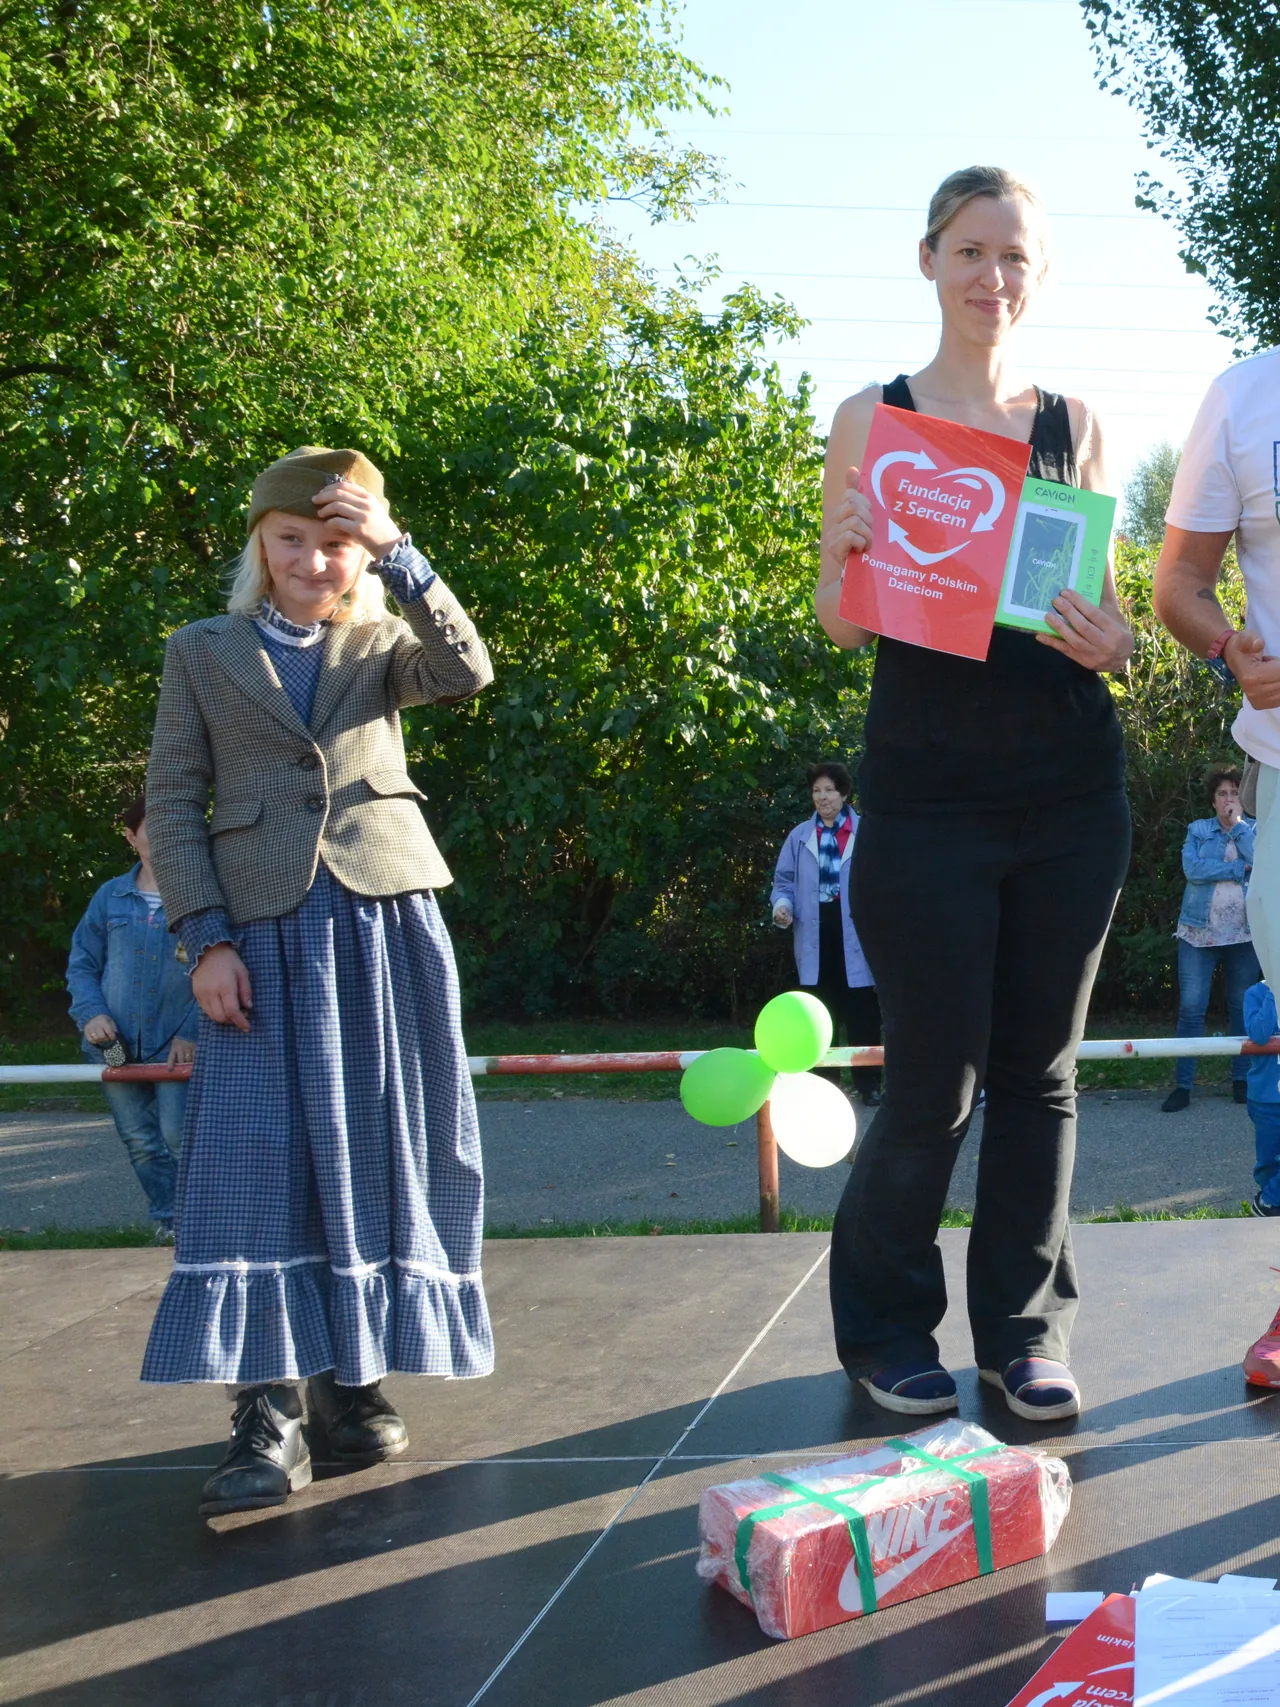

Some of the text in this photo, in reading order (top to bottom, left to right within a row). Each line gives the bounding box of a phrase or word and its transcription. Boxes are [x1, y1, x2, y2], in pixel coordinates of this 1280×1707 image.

[898, 478, 971, 511] Fundacja
[1035, 486, 1076, 504] CAVION
[893, 500, 967, 528] z Sercem
[861, 553, 978, 593] Pomagamy Polskim
[1032, 557, 1057, 569] CAVION
[888, 577, 943, 600] Dzieciom
[867, 1489, 956, 1562] NIKE
[1096, 1634, 1135, 1649] lskim
[1085, 1685, 1134, 1703] rcem
